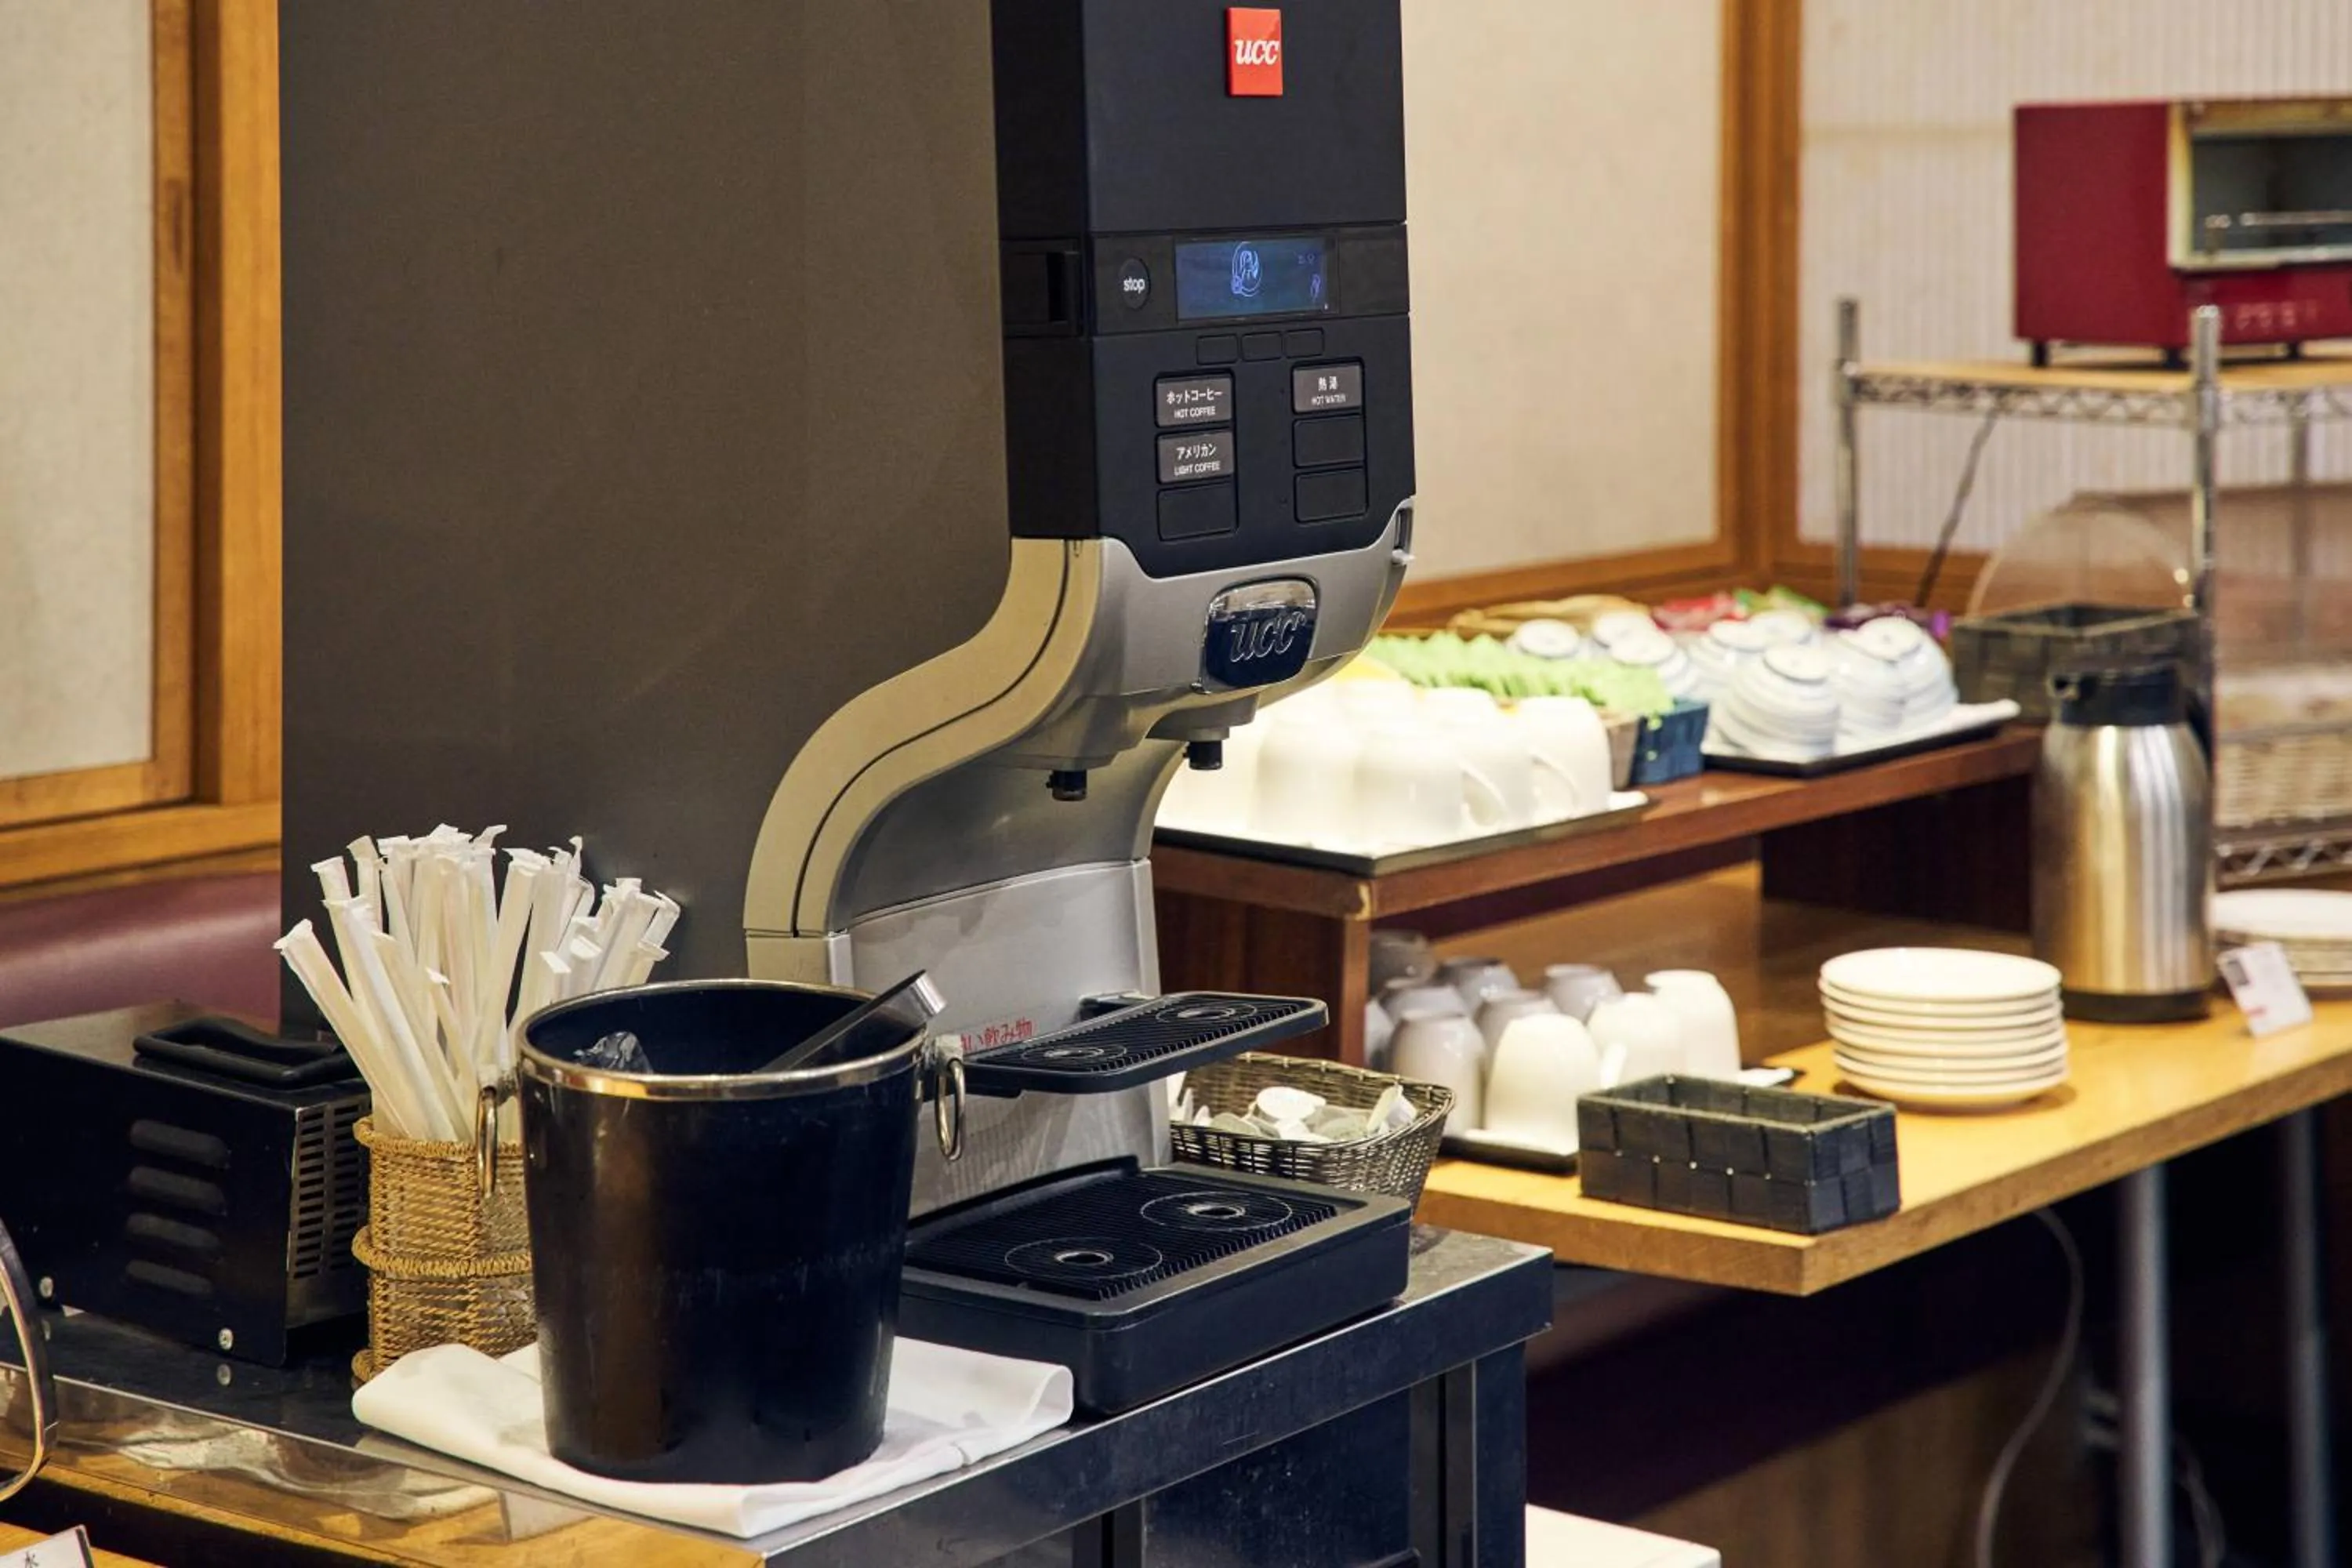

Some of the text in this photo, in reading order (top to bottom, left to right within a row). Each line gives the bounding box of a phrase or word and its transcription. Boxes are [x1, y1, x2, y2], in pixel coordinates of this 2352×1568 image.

[1123, 277, 1145, 294] stop
[1166, 387, 1223, 405] ホットコーヒー
[1174, 405, 1216, 418] HOT COFFEE
[1176, 443, 1217, 459] アメリカン
[1174, 460, 1221, 476] LIGHT COFFEE
[960, 1017, 1033, 1051] い飲み物
